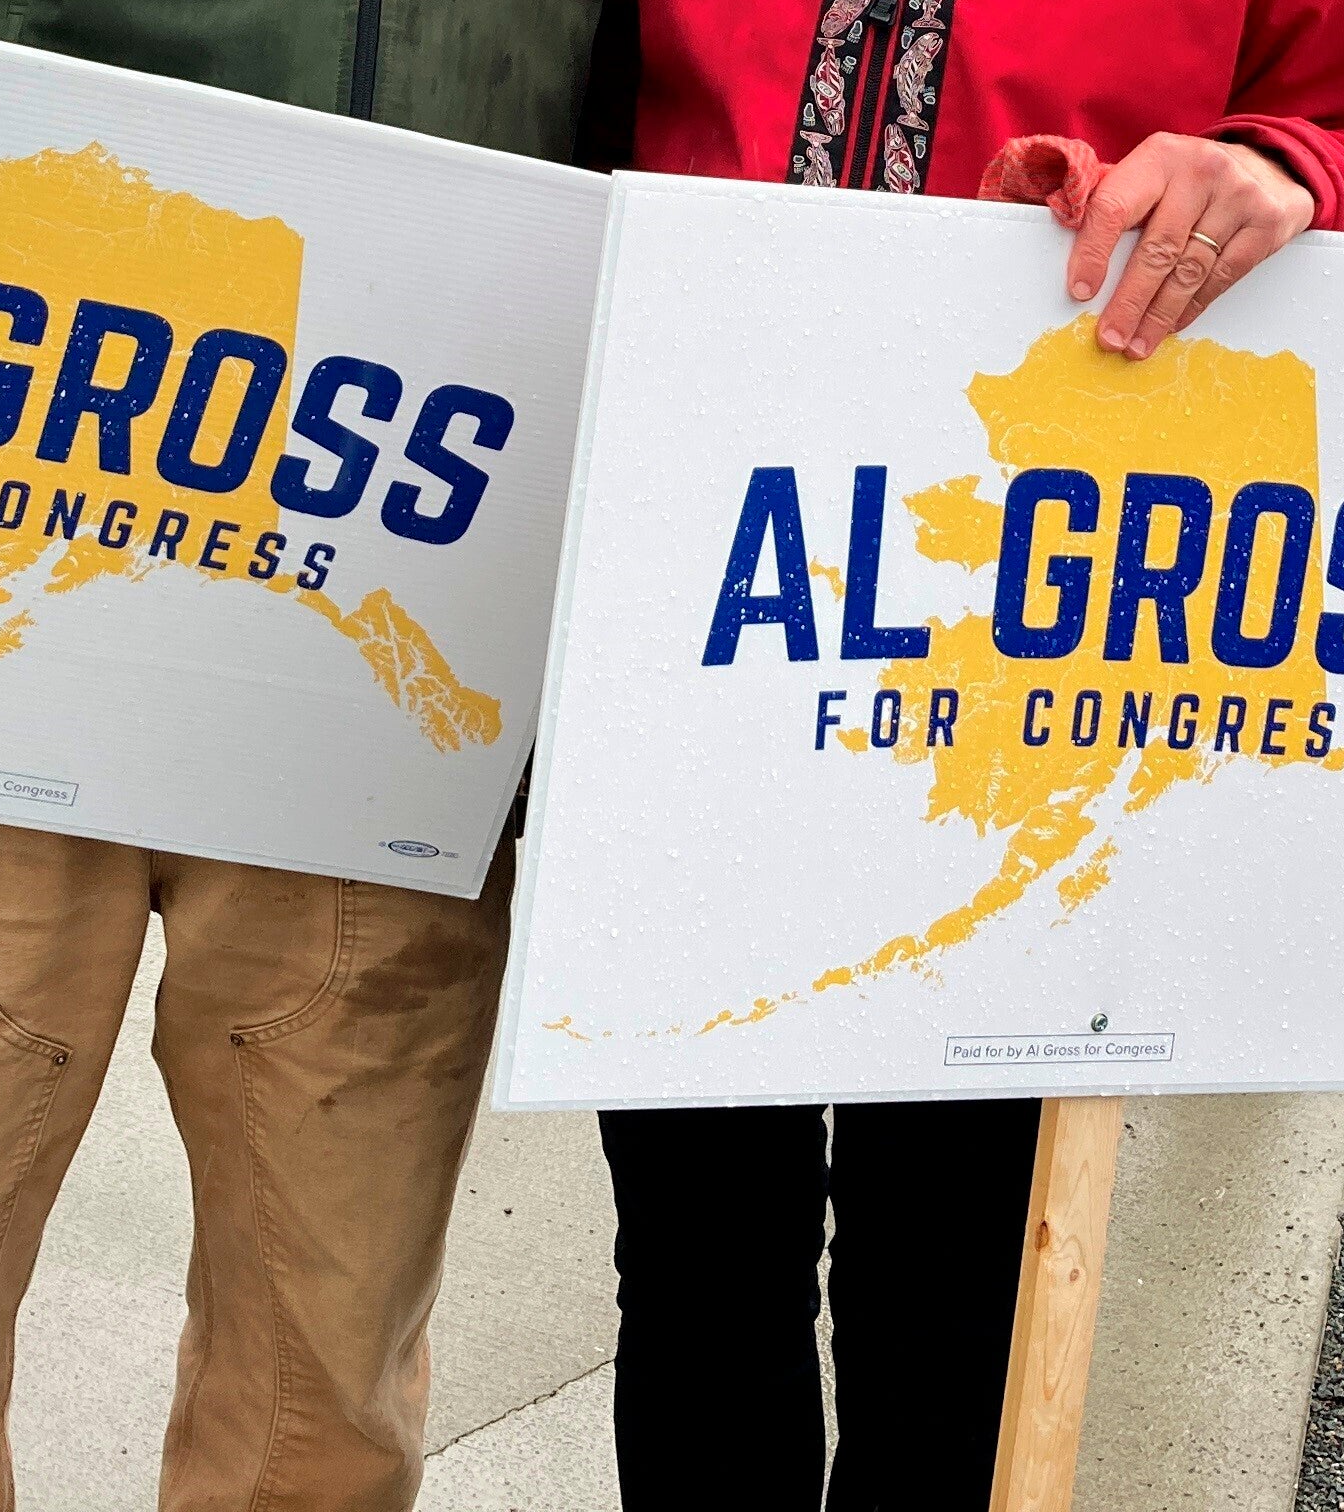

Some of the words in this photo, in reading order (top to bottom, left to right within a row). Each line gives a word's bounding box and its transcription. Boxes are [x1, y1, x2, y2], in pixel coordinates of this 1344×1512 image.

[701, 465, 931, 667] AL
[814, 688, 960, 751] FOR
[3, 779, 68, 801] Congress
[953, 1045, 982, 1059] Paid
[985, 1044, 1004, 1058] for
[1007, 1044, 1023, 1060] by
[1026, 1043, 1040, 1057] Al
[1043, 1043, 1080, 1057] Gross
[1084, 1042, 1102, 1055] for
[1105, 1041, 1167, 1058] Congress
